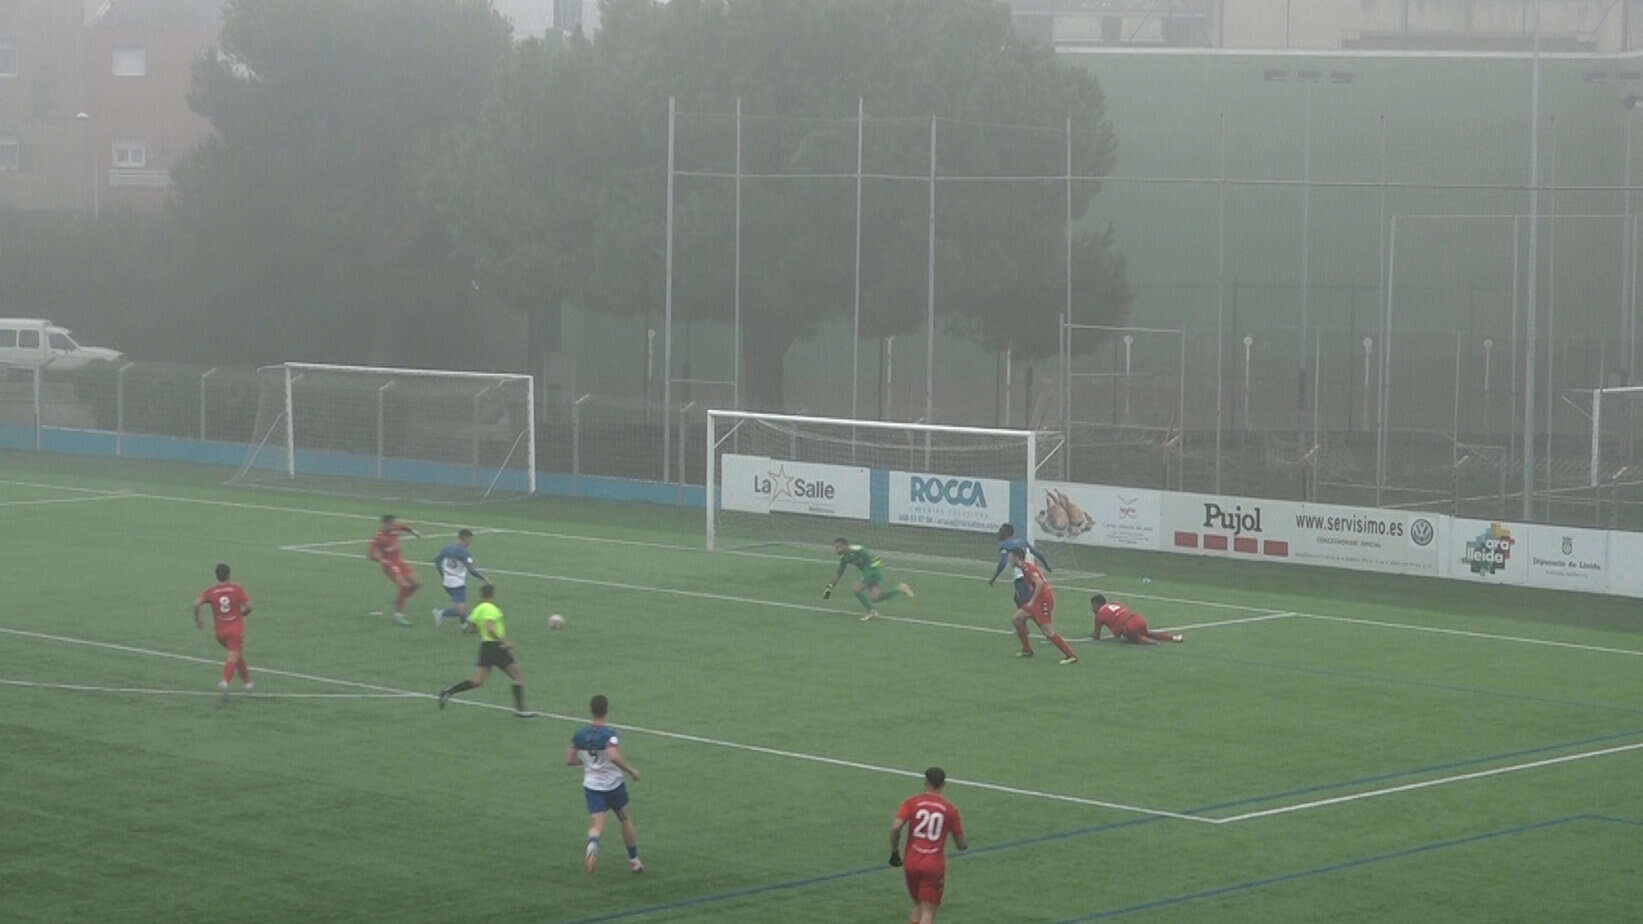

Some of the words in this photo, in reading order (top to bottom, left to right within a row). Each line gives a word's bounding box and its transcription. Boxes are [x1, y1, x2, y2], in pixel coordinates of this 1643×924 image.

[754, 474, 772, 494] La
[794, 478, 835, 500] Salle
[910, 475, 987, 508] ROCCA
[1203, 502, 1263, 535] Pujol
[1295, 514, 1404, 537] www.servisimo.es
[1466, 542, 1504, 563] lleida
[1485, 538, 1510, 551] ara
[219, 596, 231, 613] 8
[912, 809, 944, 841] 20
